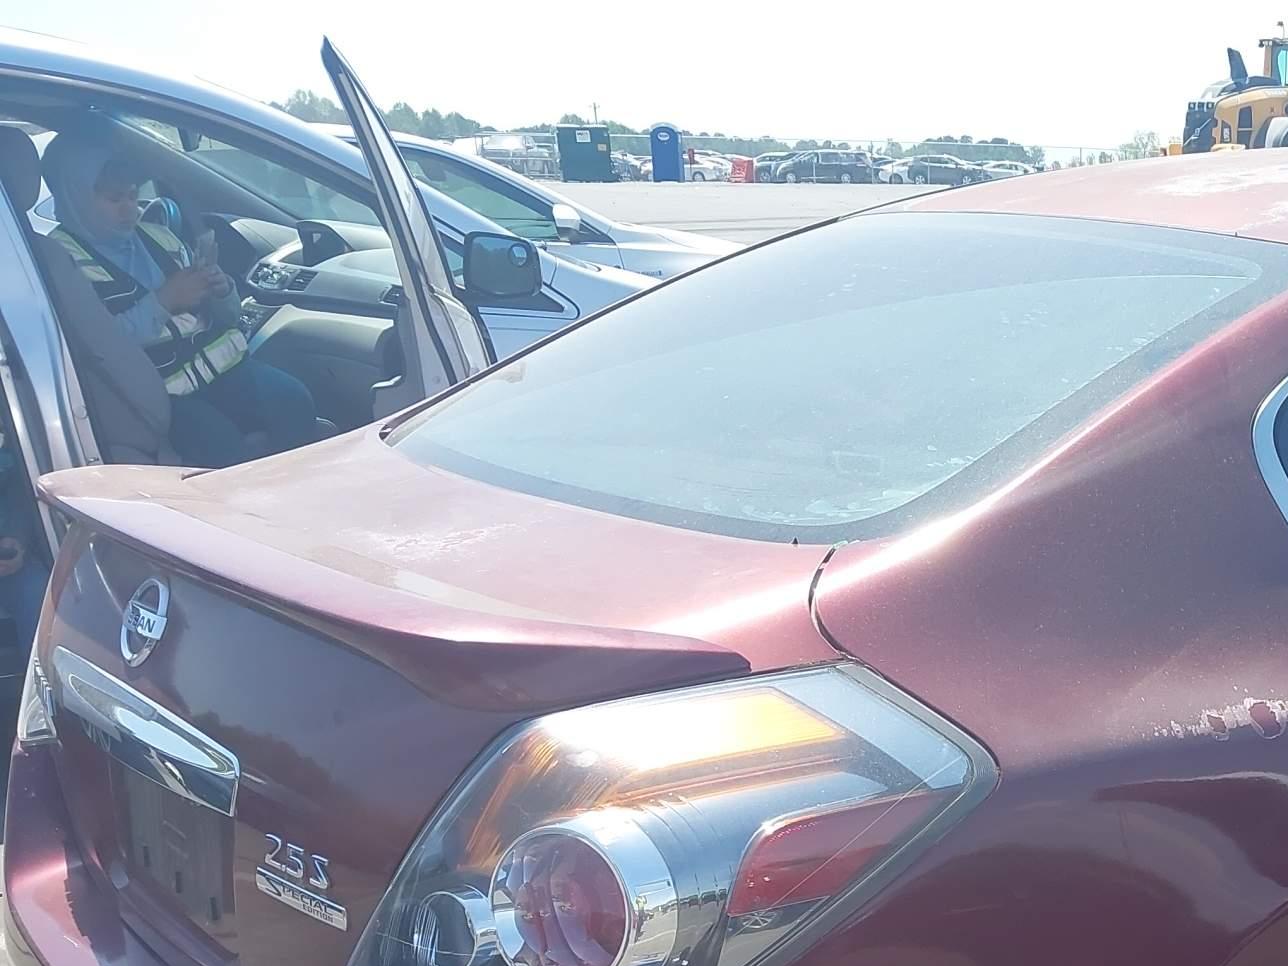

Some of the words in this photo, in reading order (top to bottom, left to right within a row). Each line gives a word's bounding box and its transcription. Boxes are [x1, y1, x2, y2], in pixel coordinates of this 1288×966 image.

[309, 853, 329, 890] S
[264, 875, 334, 917] SPECIAL
[302, 903, 334, 924] EDITION
